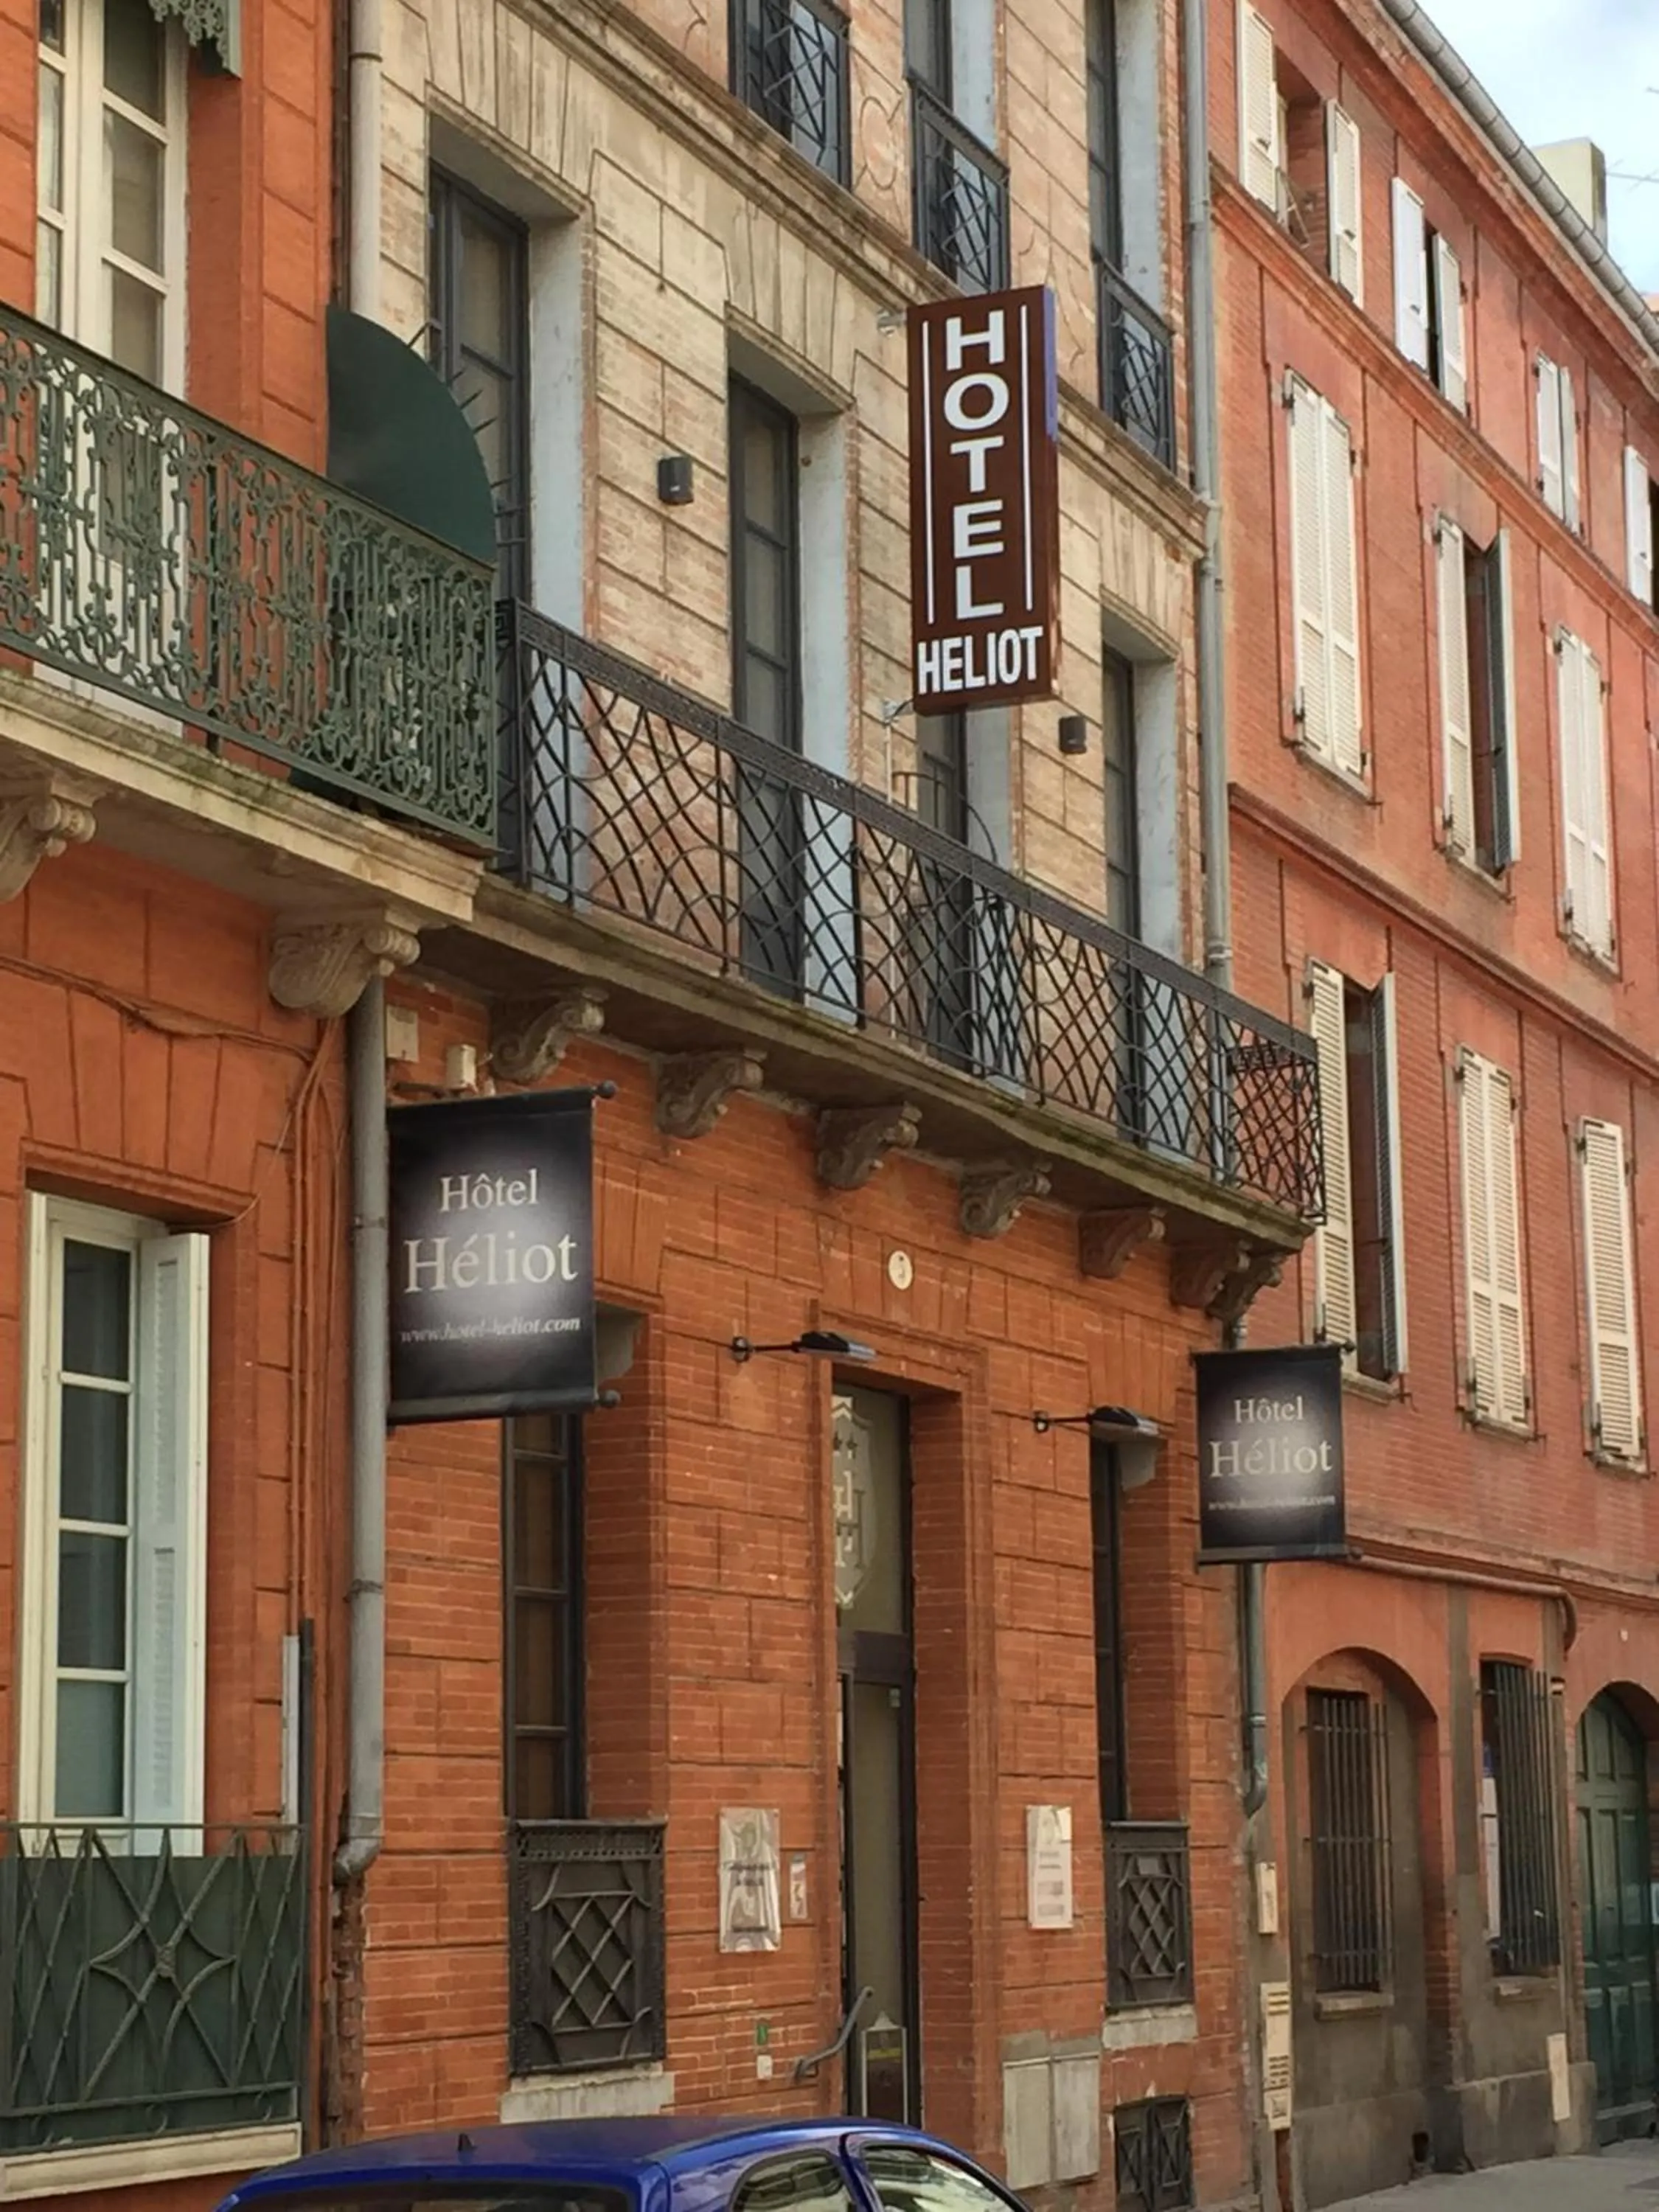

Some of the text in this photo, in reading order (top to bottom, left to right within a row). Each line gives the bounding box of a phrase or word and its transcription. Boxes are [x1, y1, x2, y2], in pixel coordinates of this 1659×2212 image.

[944, 309, 1009, 620] HOTEL
[917, 626, 1043, 695] HELIOT
[439, 1168, 539, 1212] Hôtel
[403, 1231, 578, 1293] Héliot
[1234, 1396, 1304, 1423] Hôtel
[1208, 1438, 1332, 1478] Héliot
